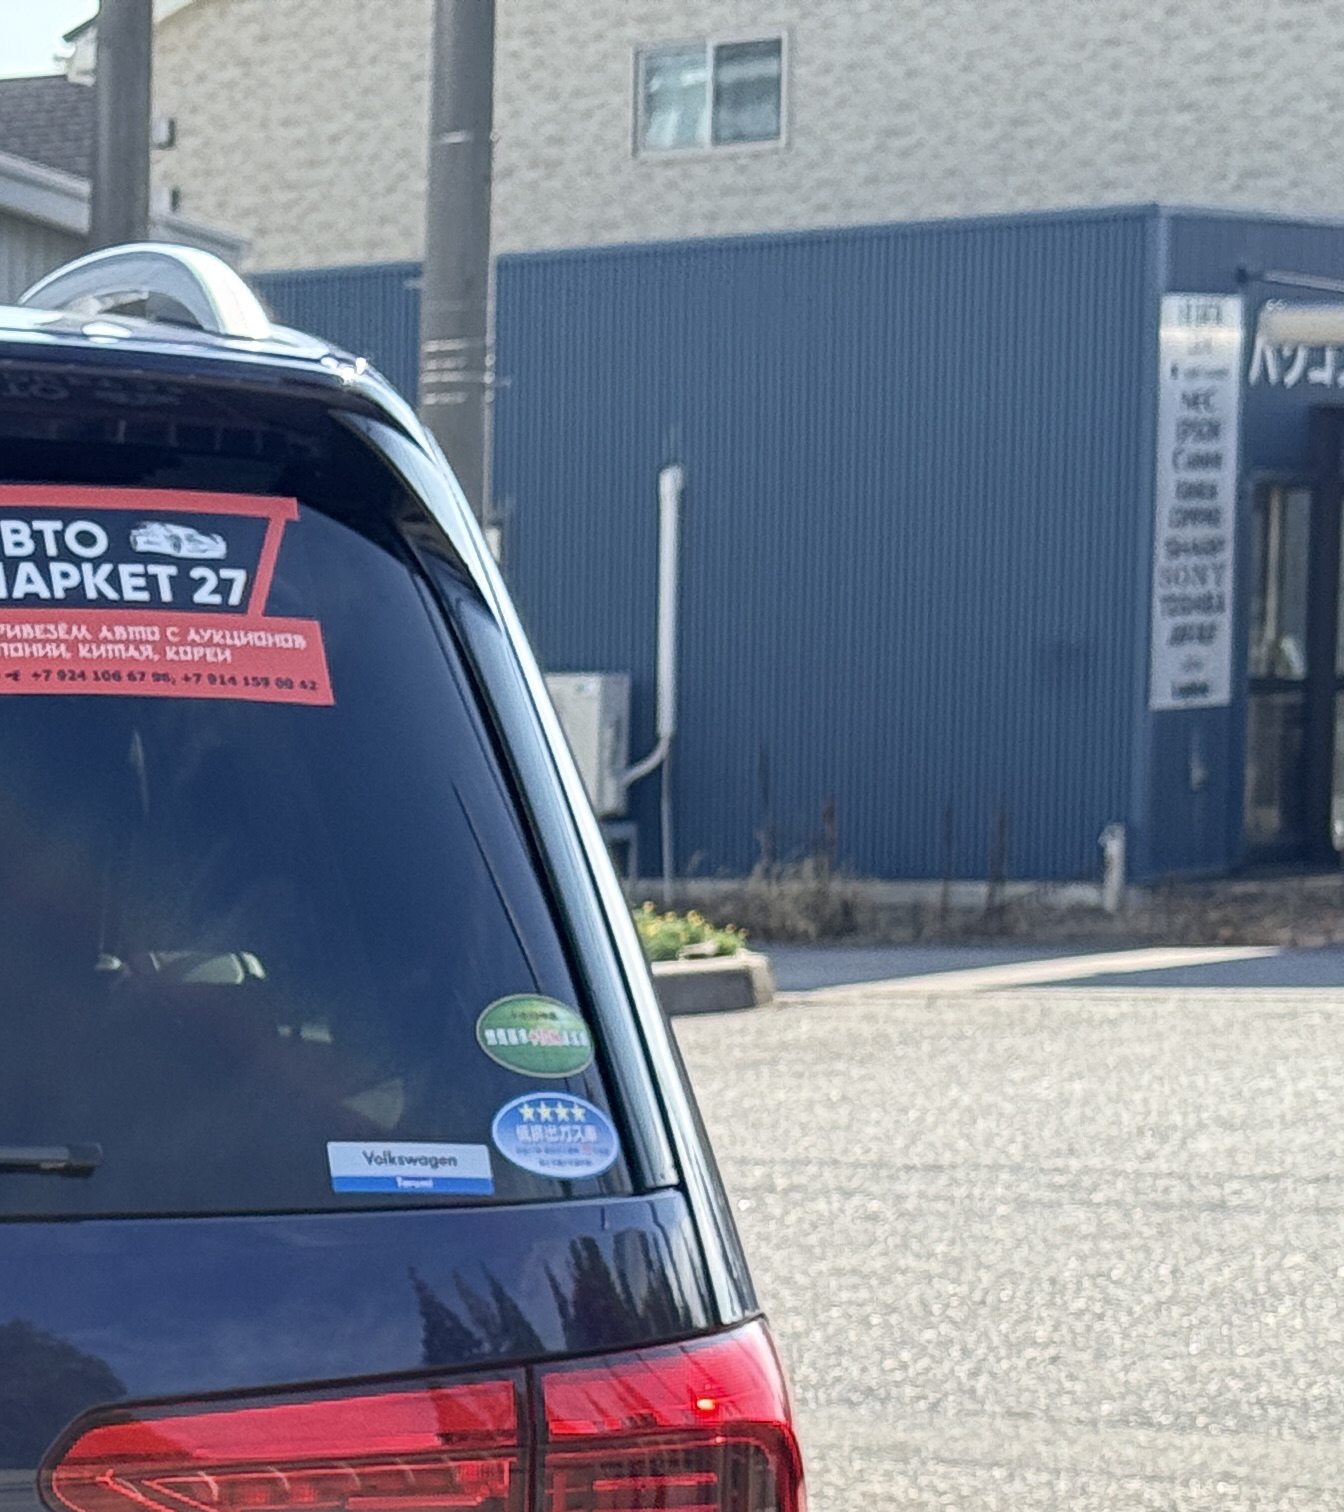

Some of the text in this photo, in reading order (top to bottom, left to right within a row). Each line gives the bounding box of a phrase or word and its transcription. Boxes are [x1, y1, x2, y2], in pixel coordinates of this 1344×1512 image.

[189, 567, 248, 606] 27
[166, 626, 180, 642] С
[362, 1150, 459, 1170] Volkswagen
